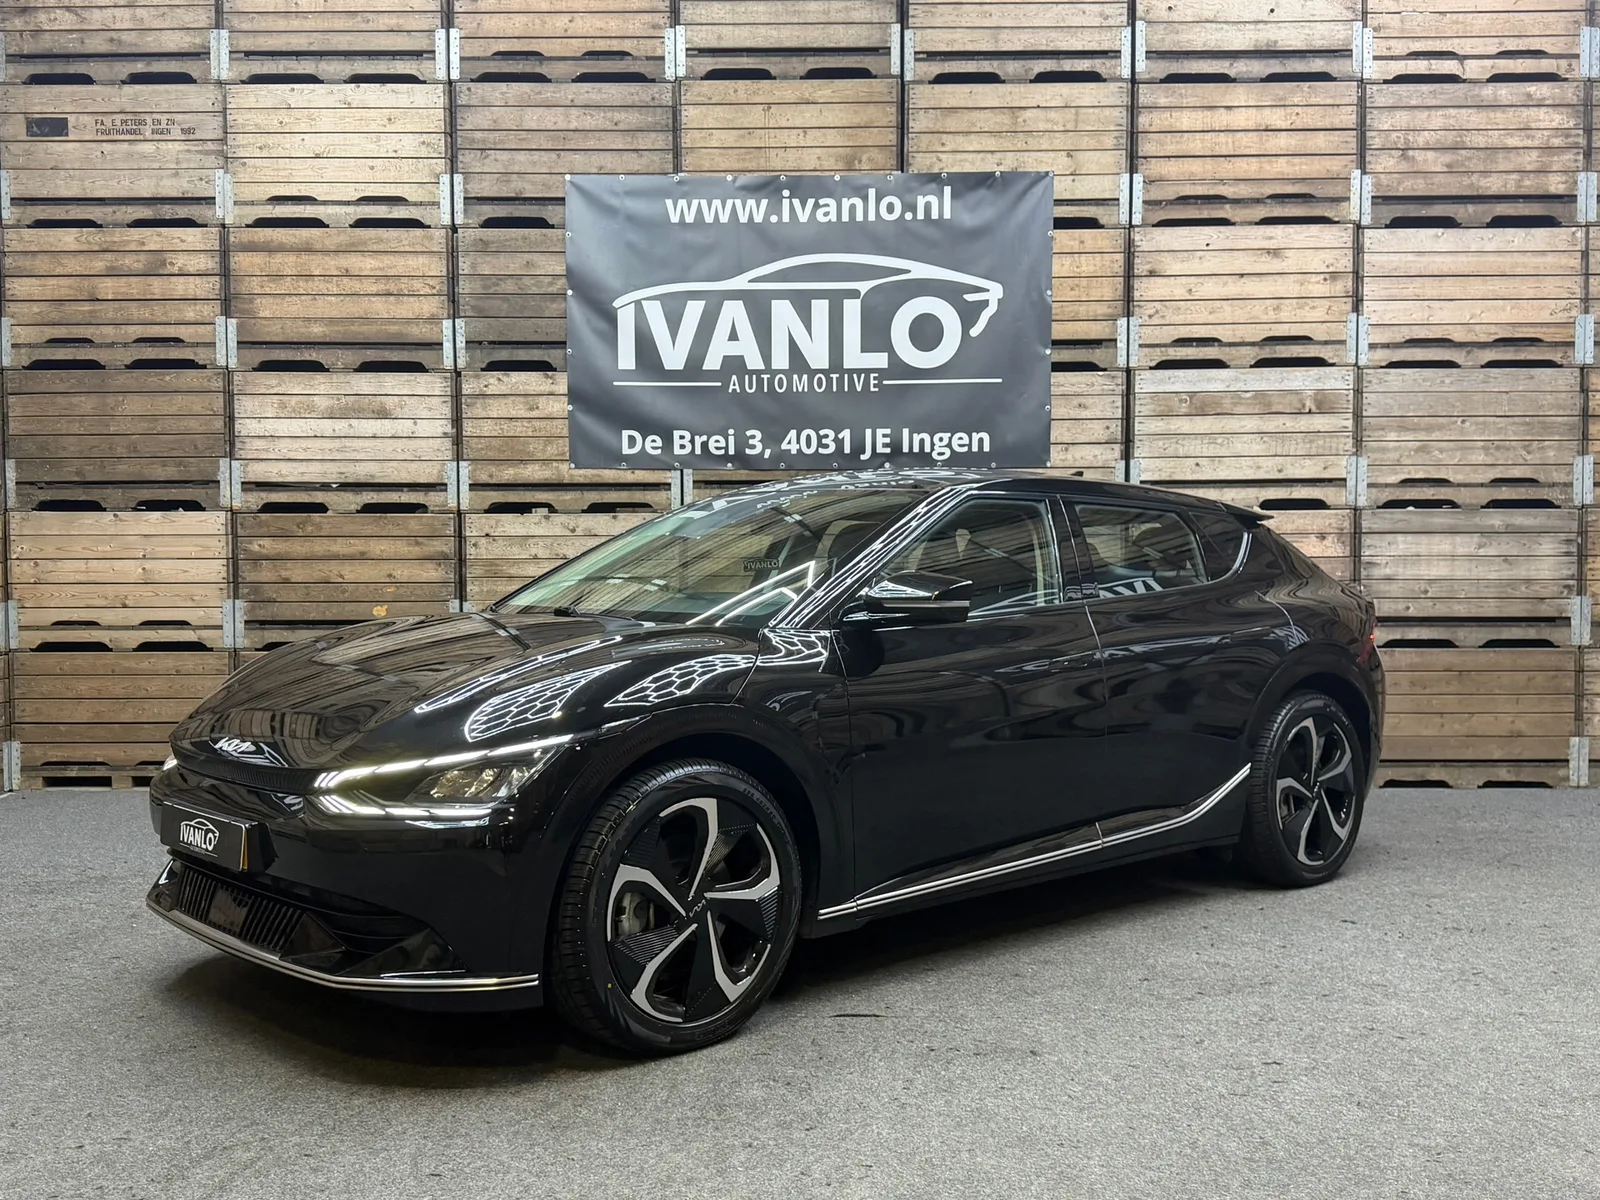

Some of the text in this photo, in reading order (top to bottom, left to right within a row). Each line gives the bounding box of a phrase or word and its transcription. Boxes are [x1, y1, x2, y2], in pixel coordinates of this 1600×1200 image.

[95, 127, 196, 136] FRUITHANDEL INGEN 1992
[120, 118, 148, 127] PETERS
[151, 118, 162, 126] EN
[665, 186, 953, 224] www.ivanlo.nl
[616, 296, 963, 371] IVANLO
[728, 373, 880, 394] AUTOMOTIVE
[621, 427, 990, 461] De Brei 3, 4031 JE Ingen
[747, 560, 779, 570] IVANLO
[179, 823, 215, 851] IVANLO
